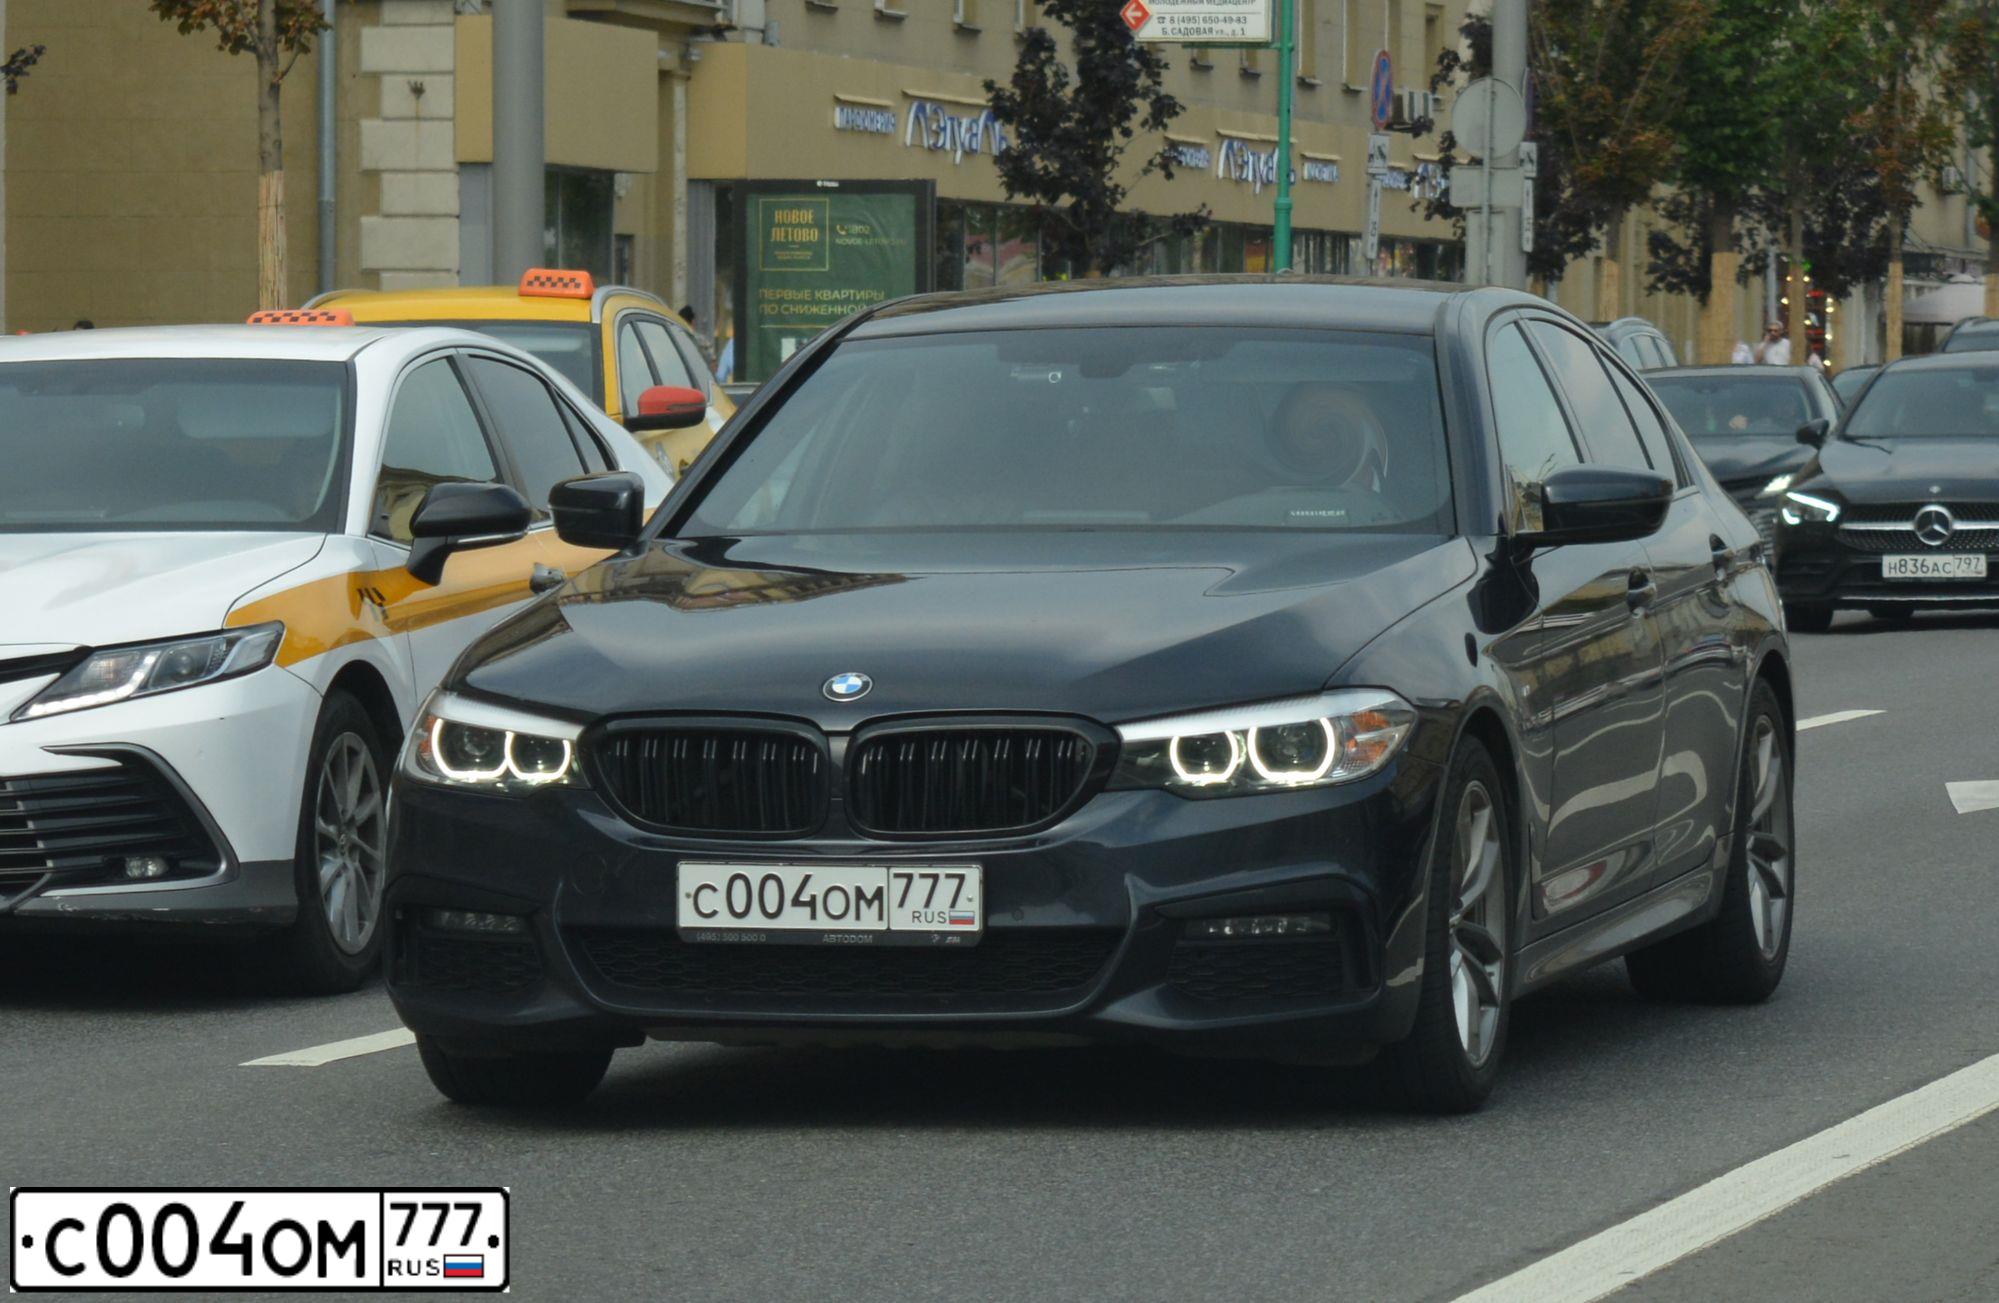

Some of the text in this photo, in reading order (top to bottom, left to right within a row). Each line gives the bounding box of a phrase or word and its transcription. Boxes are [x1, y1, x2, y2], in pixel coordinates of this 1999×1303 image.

[1169, 16, 1175, 24] 8
[1177, 16, 1200, 25] (495)
[1161, 27, 1169, 36] Б.
[1171, 27, 1214, 37] САДОВАЯ
[774, 208, 814, 225] НОВОЕ
[770, 227, 819, 242] ЛЕТОВО
[759, 289, 885, 301] ПЕРВЫЕ КВАРТИРЫ
[759, 303, 778, 315] ПО
[1888, 556, 1981, 575] Н836АС 797
[692, 872, 966, 922] С004ОМ 777
[911, 910, 947, 924] RUS
[822, 934, 873, 944] АВТОДОМ
